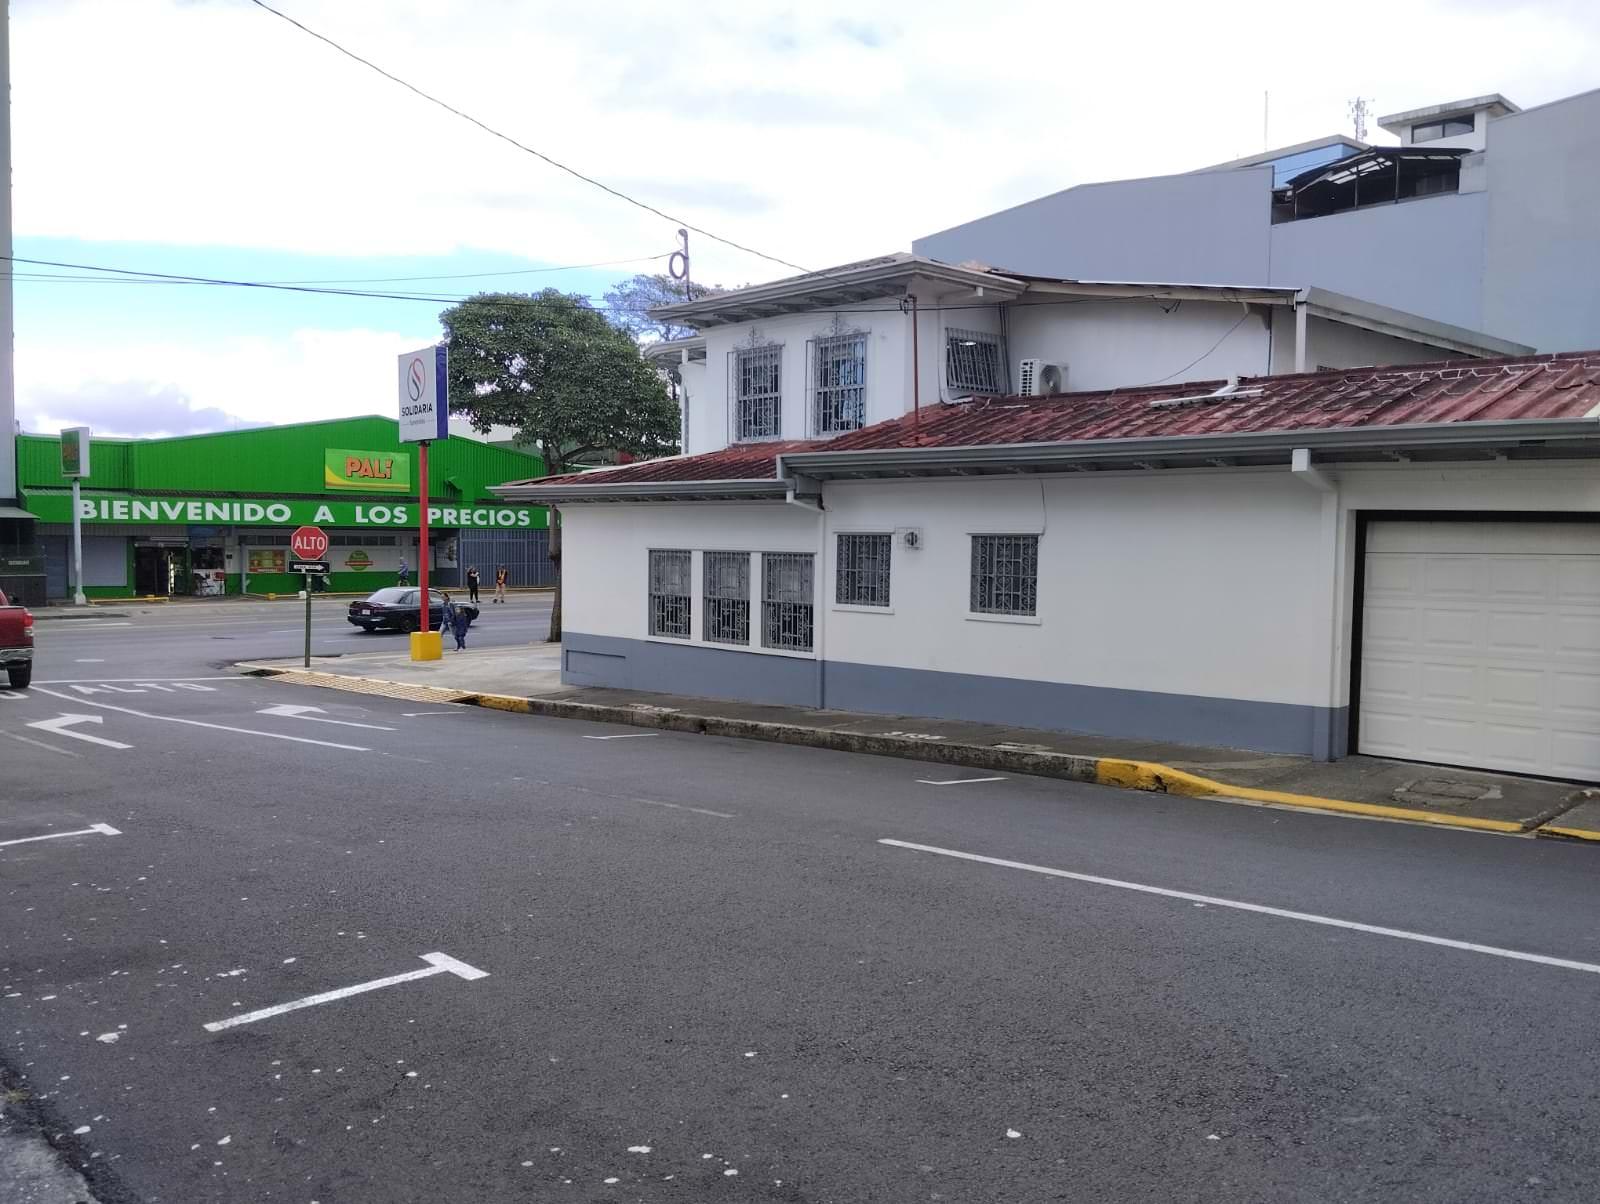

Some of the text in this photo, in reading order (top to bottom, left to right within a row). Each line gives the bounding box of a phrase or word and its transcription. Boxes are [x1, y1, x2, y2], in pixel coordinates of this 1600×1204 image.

[401, 403, 433, 417] SOLIDARIA
[79, 499, 291, 523] BIENVENIDO
[313, 505, 336, 523] A
[355, 505, 408, 524] LOS
[428, 507, 531, 527] PRECIOS
[294, 535, 326, 551] ALTO
[69, 682, 217, 696] ALTO
